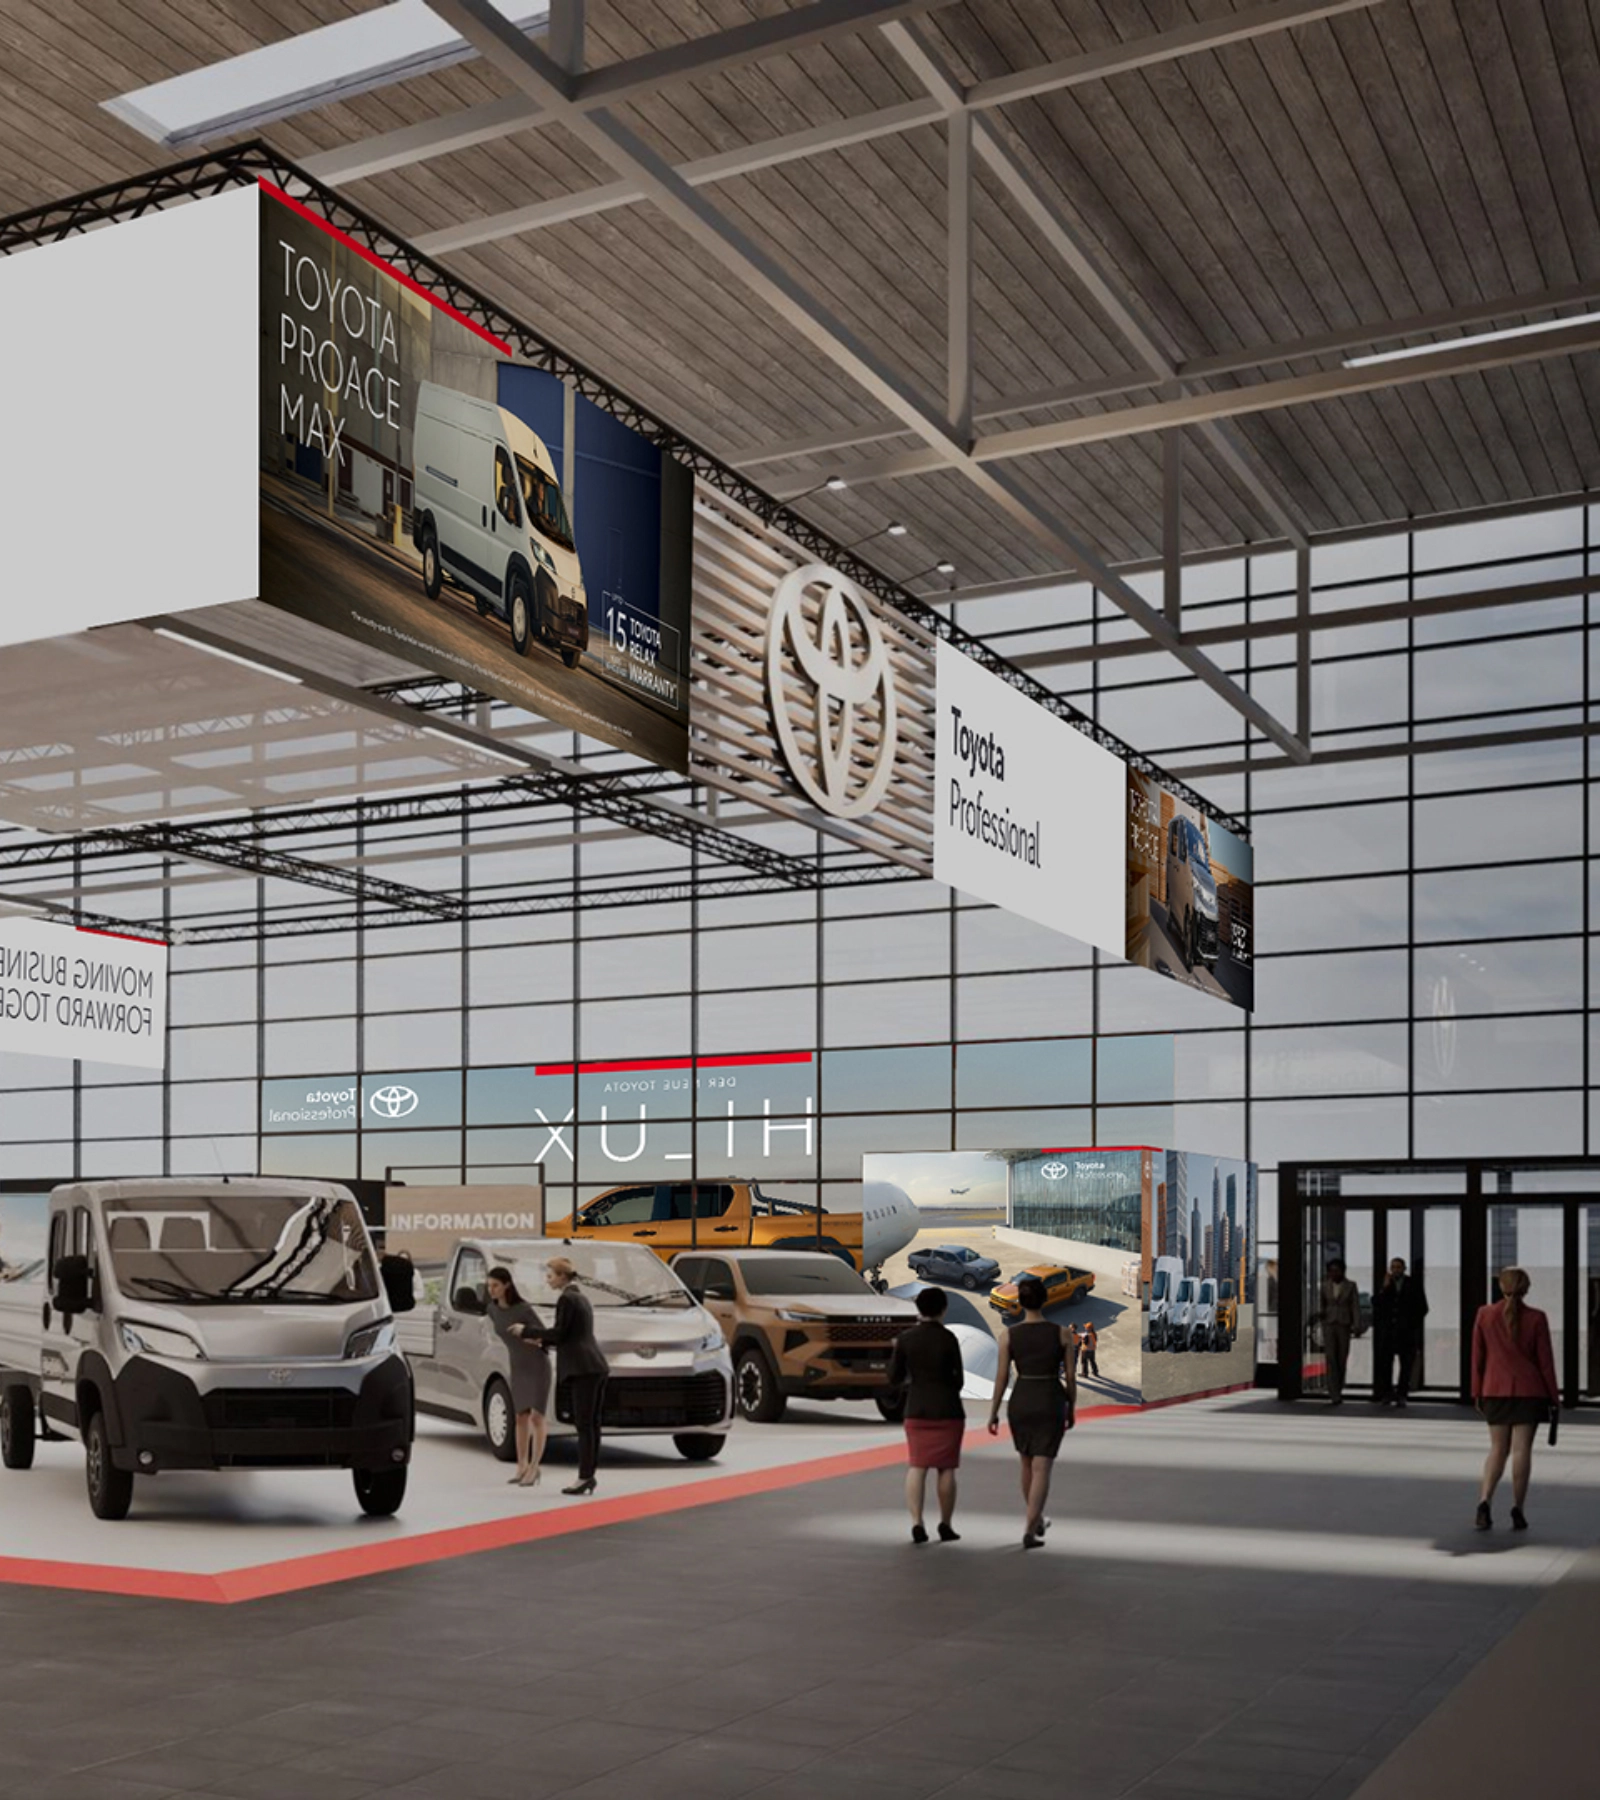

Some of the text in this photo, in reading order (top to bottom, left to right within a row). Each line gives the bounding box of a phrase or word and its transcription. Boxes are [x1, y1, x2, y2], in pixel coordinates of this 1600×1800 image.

[279, 240, 399, 364] TOYOTA
[281, 312, 400, 430] PROACE
[281, 383, 345, 467] MAX
[606, 607, 627, 652] 15
[629, 618, 662, 650] TOYOTA
[629, 641, 656, 668] RELAX
[951, 705, 1005, 781] Toyota
[950, 778, 1041, 869] Professional
[391, 1213, 535, 1230] INFORMATION
